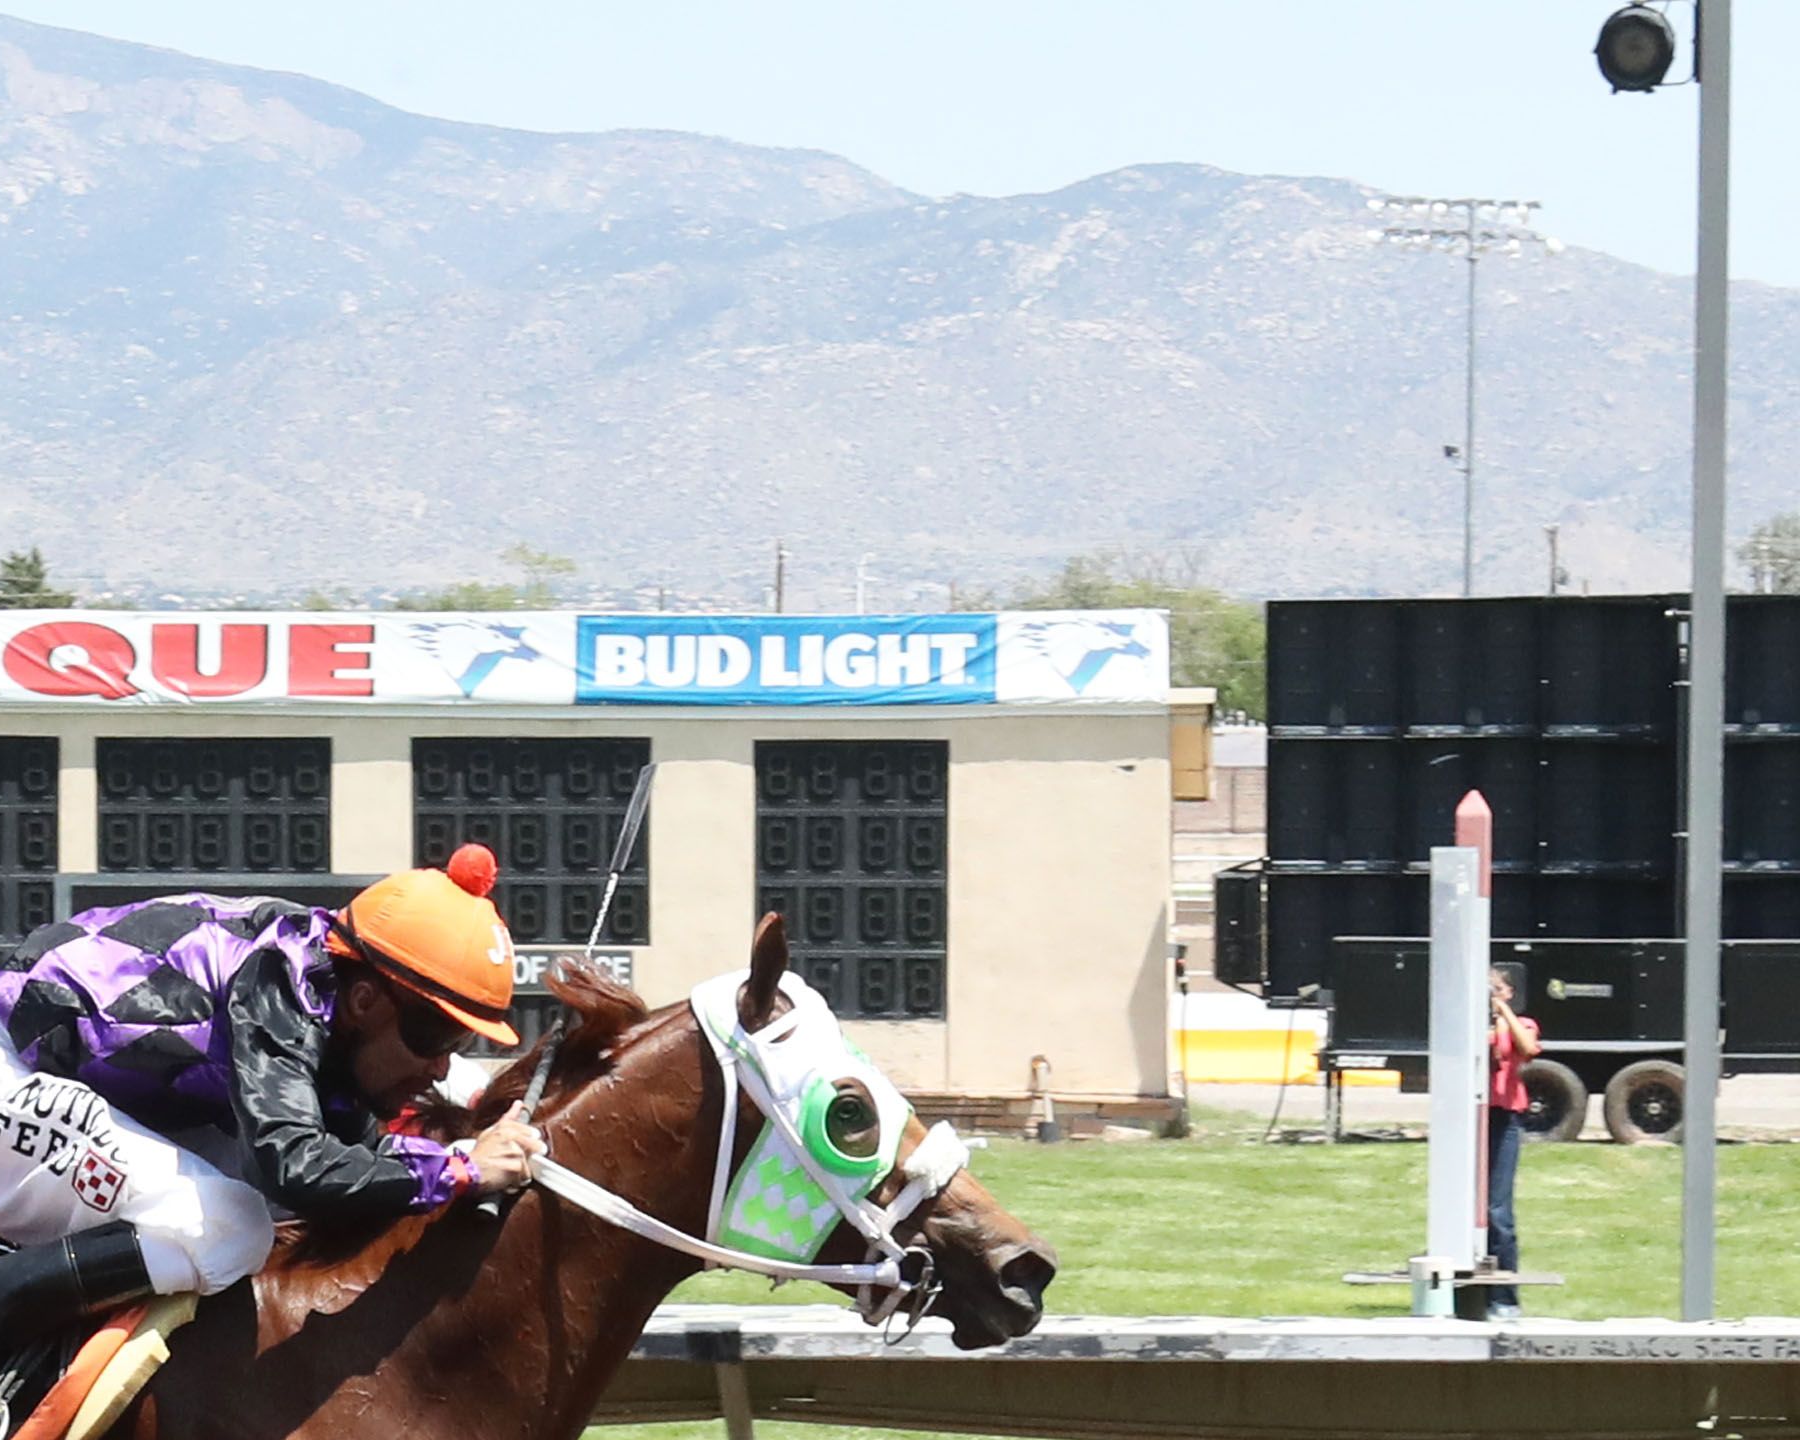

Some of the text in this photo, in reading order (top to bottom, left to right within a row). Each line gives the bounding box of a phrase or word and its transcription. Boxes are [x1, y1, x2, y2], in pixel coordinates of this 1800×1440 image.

[594, 632, 978, 687] BUD LIGHT
[513, 955, 548, 985] OF
